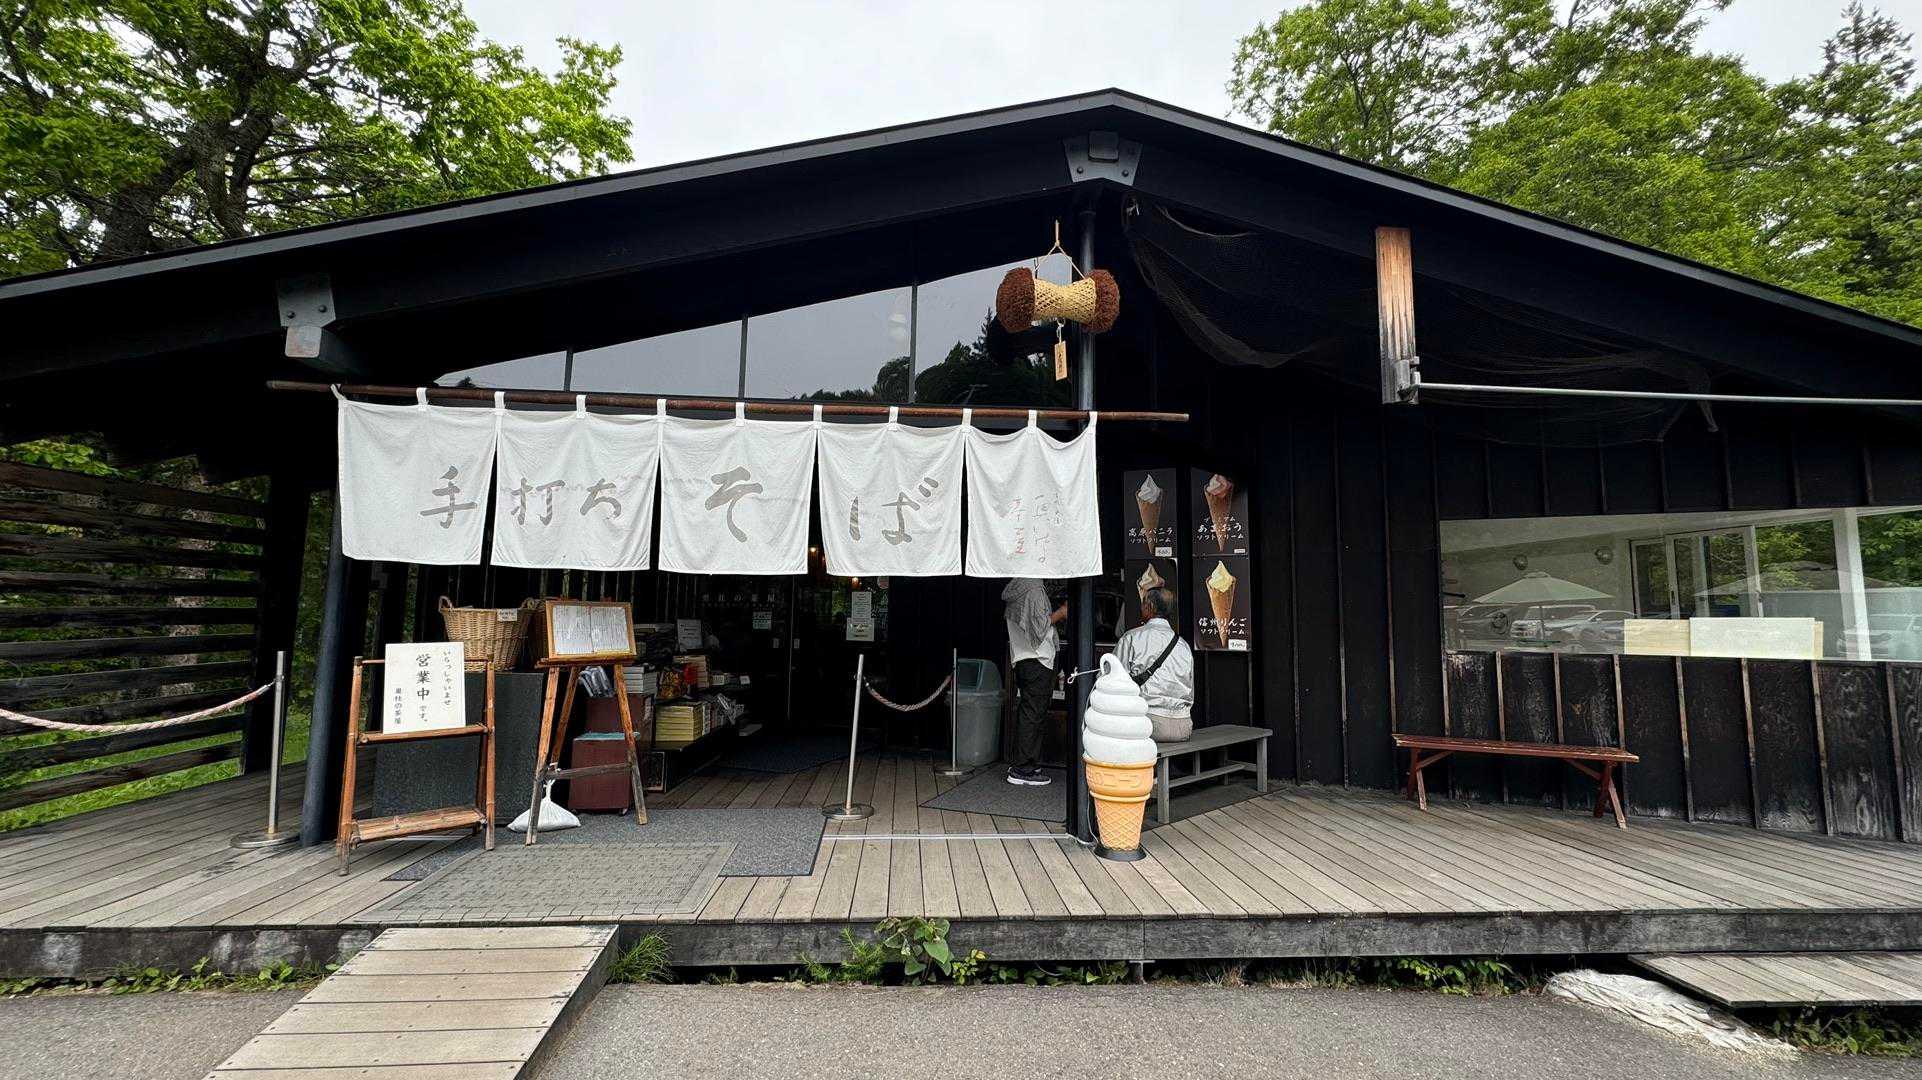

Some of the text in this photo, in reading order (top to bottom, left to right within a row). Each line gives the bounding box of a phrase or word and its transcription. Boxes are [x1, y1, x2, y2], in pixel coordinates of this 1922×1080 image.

[420, 466, 940, 544] 手打ちそば
[1197, 533, 1244, 541] ソフトクリーム
[1198, 617, 1247, 627] 信州りんご
[443, 651, 453, 706] いらっしゃいませ
